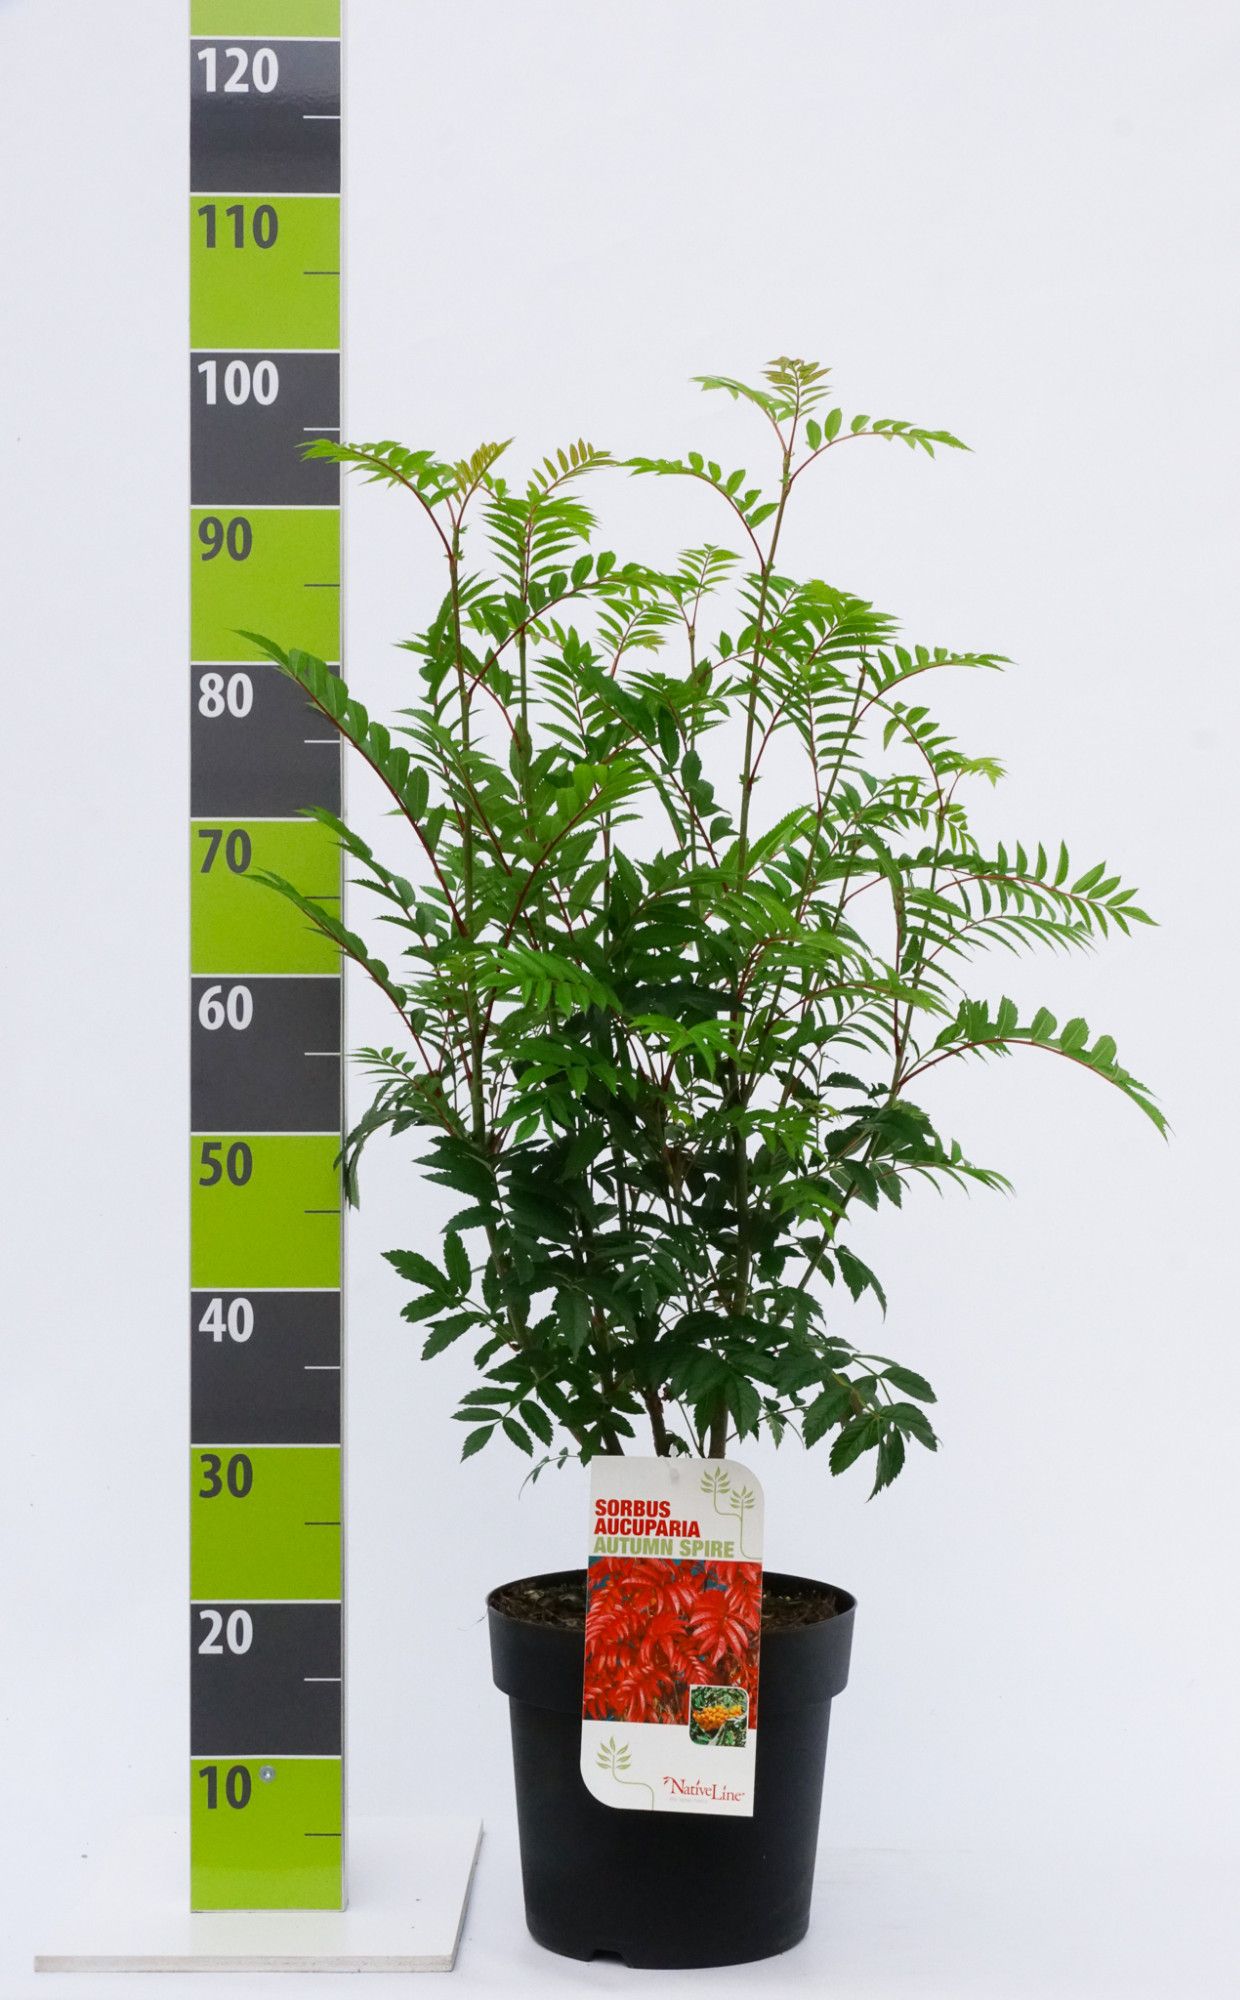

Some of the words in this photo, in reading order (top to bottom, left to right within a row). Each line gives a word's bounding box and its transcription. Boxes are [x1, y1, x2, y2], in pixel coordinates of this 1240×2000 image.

[198, 47, 279, 93] 120
[198, 204, 279, 249] 110
[198, 360, 279, 405] 100
[198, 516, 252, 561] 90
[198, 673, 253, 718] 80
[198, 829, 252, 874] 70
[198, 985, 253, 1030] 60
[199, 1142, 252, 1187] 50
[198, 1298, 254, 1343] 40
[199, 1454, 252, 1498] 30
[594, 1499, 671, 1518] SORBUS
[594, 1518, 701, 1538] AUCUPARIA
[594, 1537, 674, 1556] AUTUMN
[679, 1540, 735, 1558] SPIRE
[198, 1609, 253, 1654] 20
[199, 1766, 252, 1809] 10
